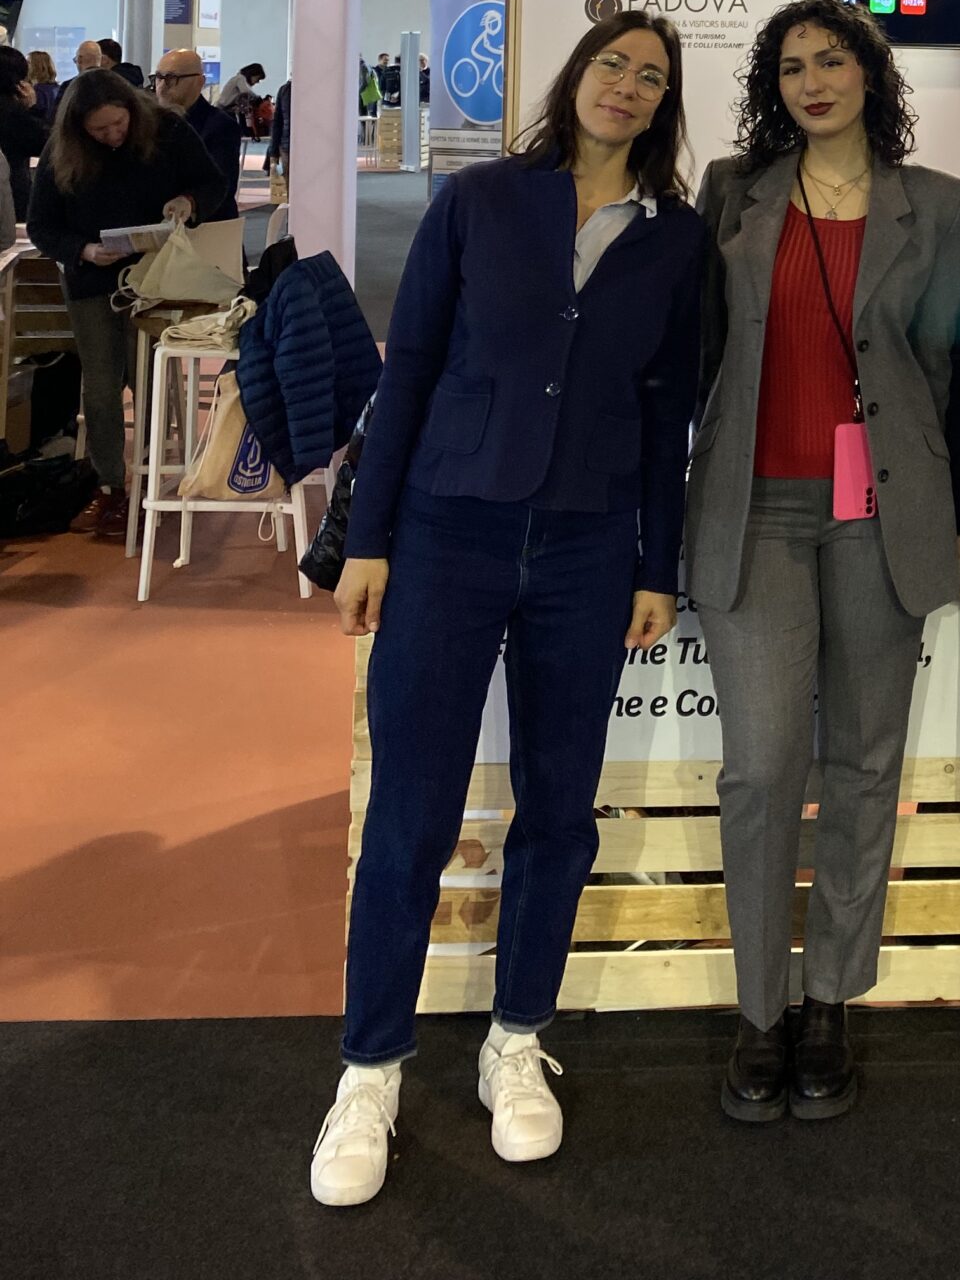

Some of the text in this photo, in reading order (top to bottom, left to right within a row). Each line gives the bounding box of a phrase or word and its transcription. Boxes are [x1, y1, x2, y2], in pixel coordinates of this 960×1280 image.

[689, 20, 720, 28] VISITORS
[720, 20, 749, 29] BUREAU
[650, 695, 668, 718] e
